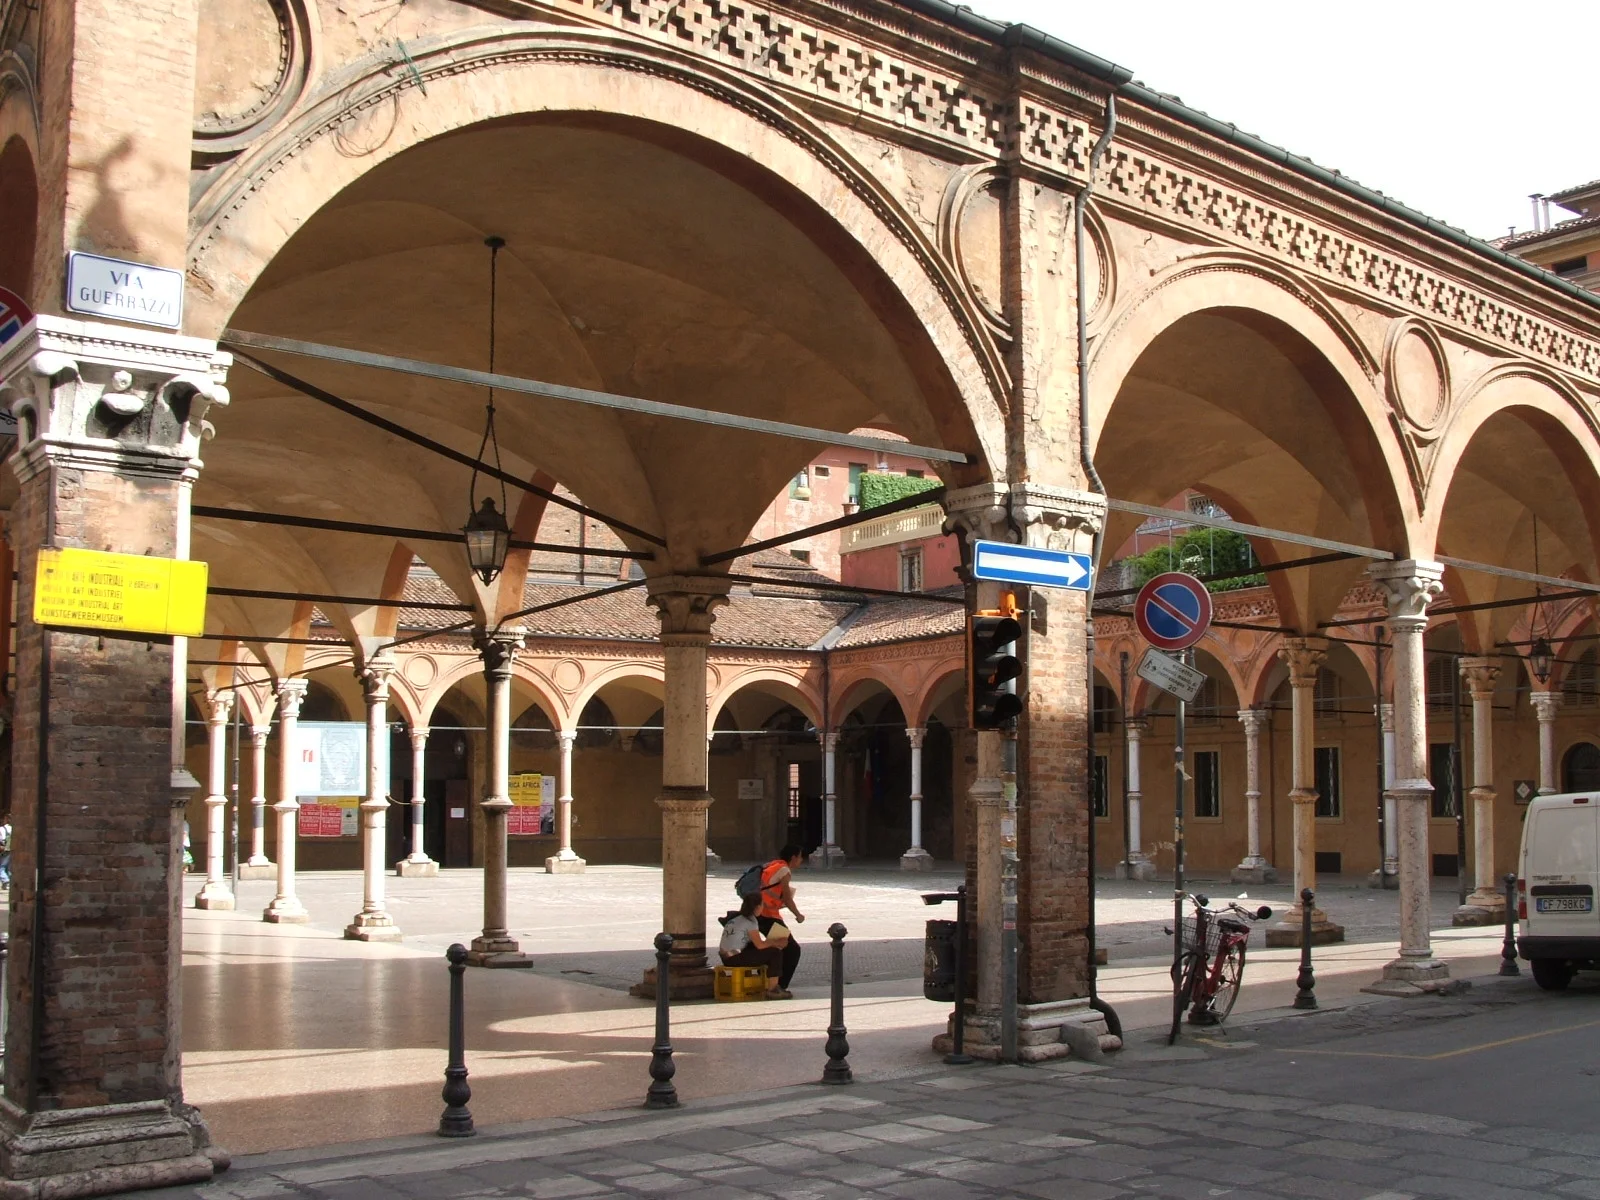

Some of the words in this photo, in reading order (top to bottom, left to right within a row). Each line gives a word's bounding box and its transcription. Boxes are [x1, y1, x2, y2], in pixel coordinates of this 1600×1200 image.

[110, 271, 143, 289] VIA
[80, 287, 171, 315] GUERRAZZI
[112, 602, 123, 611] ART
[40, 608, 124, 623] KUNSTGEWERBEMUSEUM
[1543, 899, 1554, 909] CF
[1557, 899, 1585, 909] 798KG
